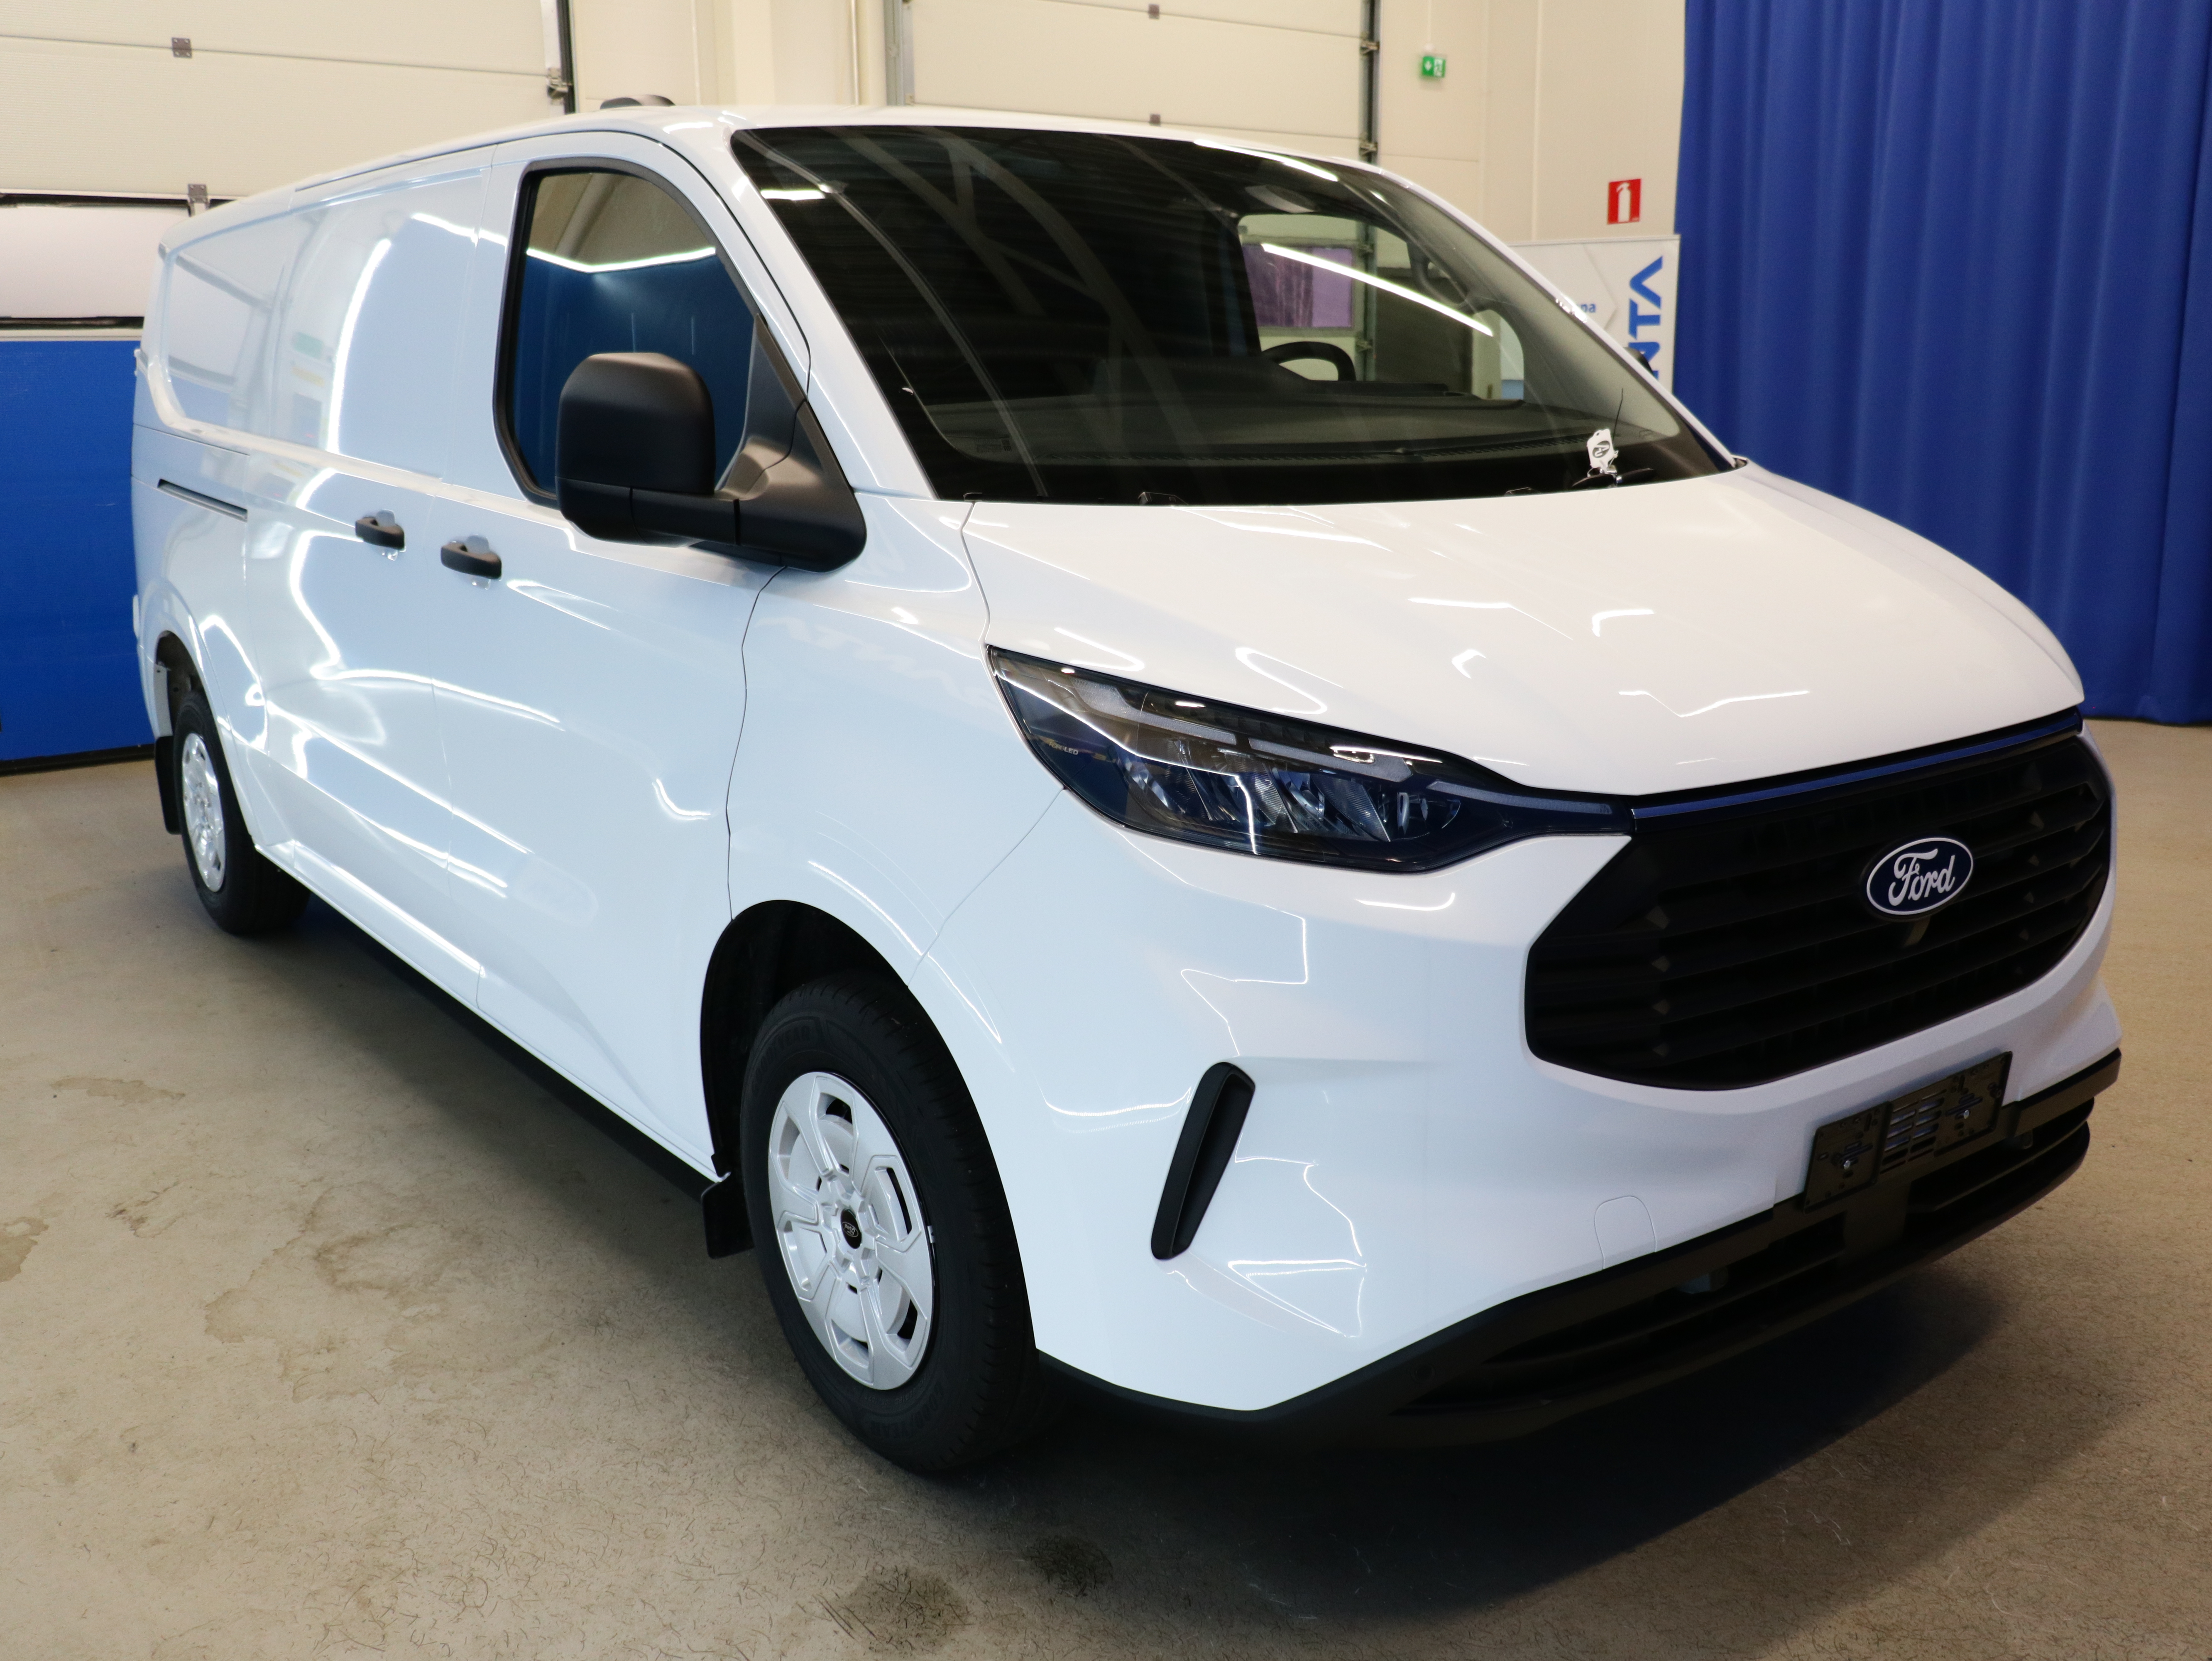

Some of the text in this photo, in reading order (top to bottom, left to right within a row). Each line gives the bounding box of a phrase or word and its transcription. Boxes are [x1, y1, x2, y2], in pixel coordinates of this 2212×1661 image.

[1888, 848, 1955, 906] Ford
[751, 1025, 810, 1097] GOODYEAR
[871, 1381, 945, 1439] GOODYEAR
